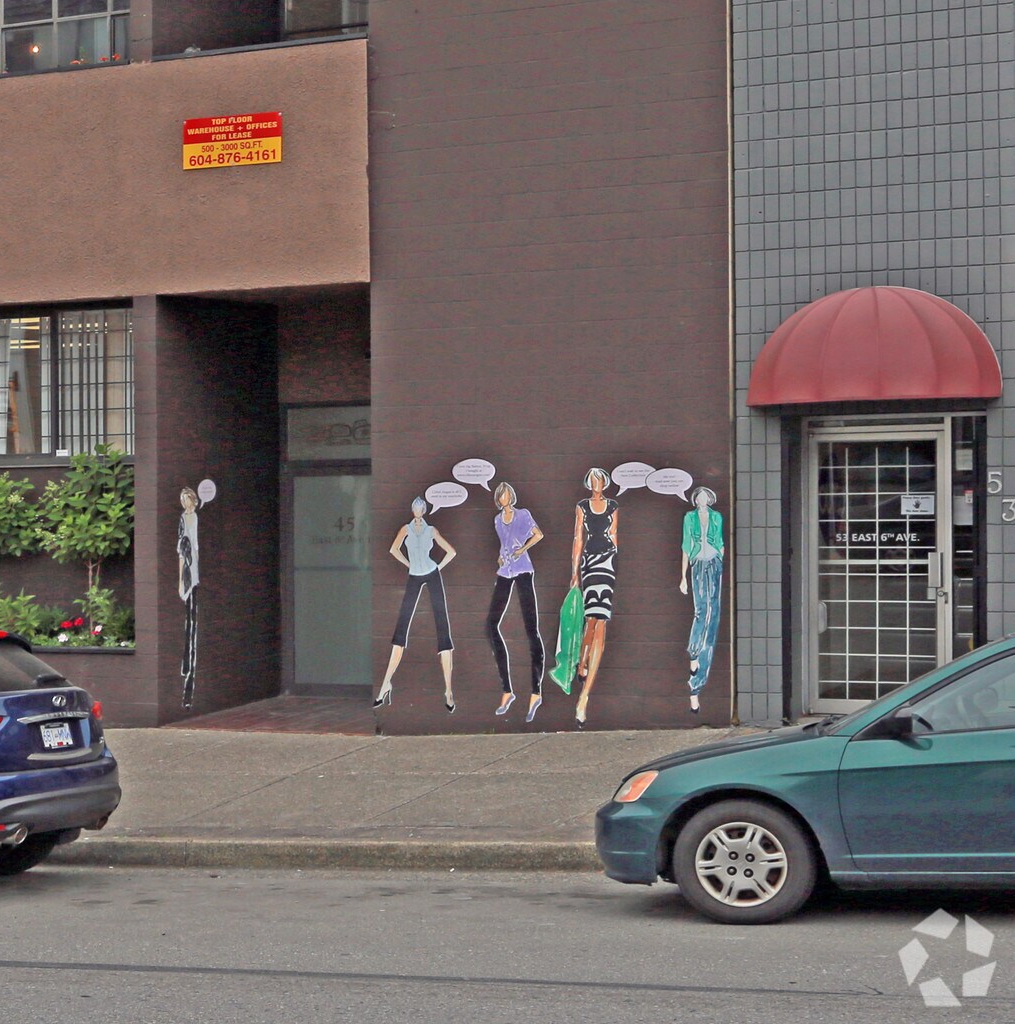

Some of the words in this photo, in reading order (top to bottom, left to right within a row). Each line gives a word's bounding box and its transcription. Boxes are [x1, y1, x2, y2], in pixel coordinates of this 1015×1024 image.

[228, 116, 252, 124] FLOOR
[187, 126, 234, 135] WAREHOUSE
[246, 122, 278, 130] OFFICES
[201, 145, 215, 153] 500
[221, 143, 238, 151] 3000
[189, 149, 276, 166] 604-876-4161
[987, 471, 1002, 494] 5
[1002, 498, 1015, 522] 3
[835, 533, 847, 542] 53
[851, 533, 877, 542] EAST
[895, 533, 920, 542] AVE.
